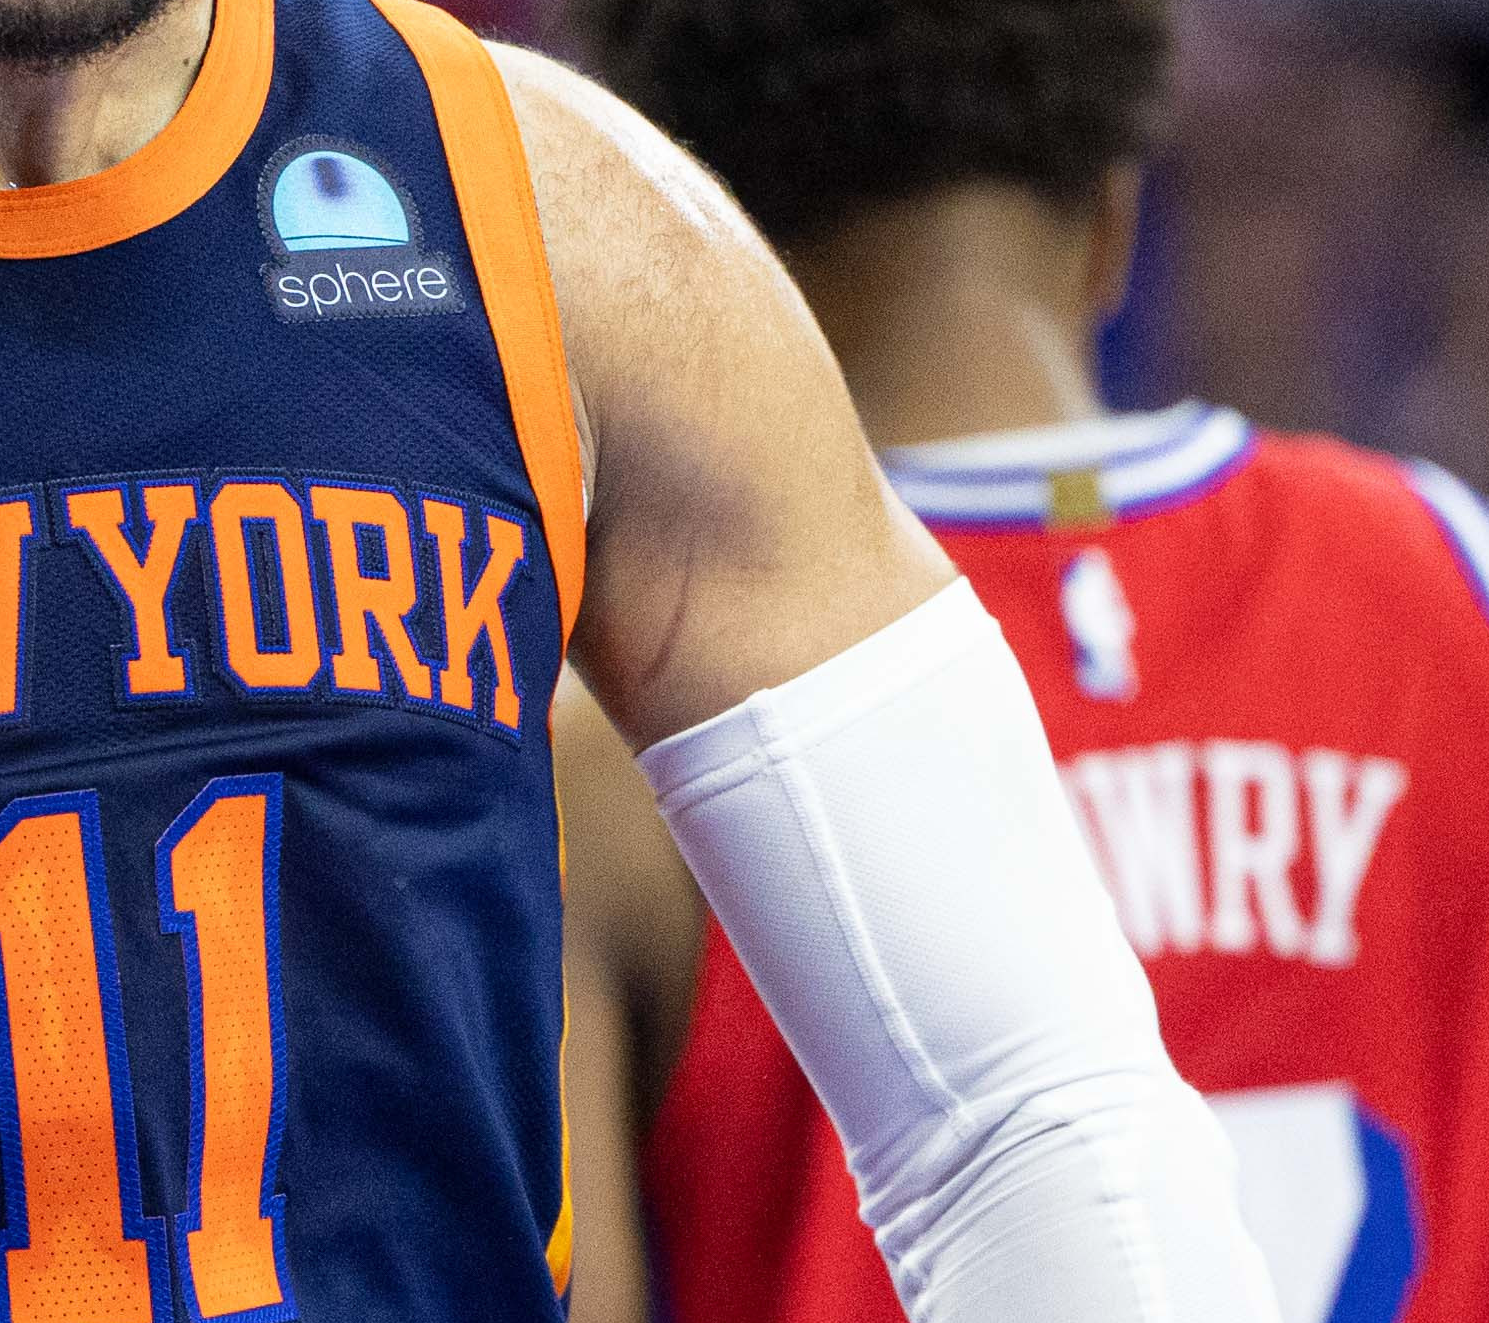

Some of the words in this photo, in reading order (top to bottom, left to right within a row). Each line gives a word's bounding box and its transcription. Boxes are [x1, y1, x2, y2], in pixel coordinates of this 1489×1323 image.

[278, 262, 448, 316] sphere
[60, 476, 527, 736] YORK
[1060, 738, 1410, 966] WRY
